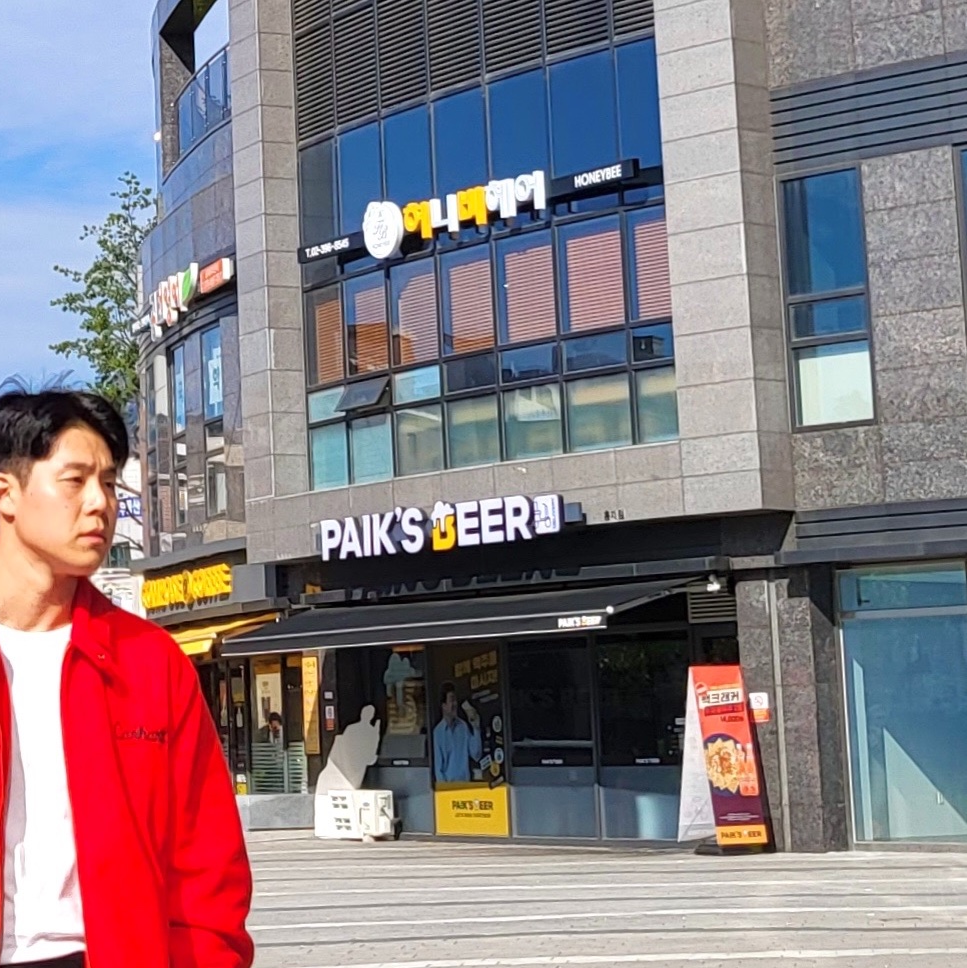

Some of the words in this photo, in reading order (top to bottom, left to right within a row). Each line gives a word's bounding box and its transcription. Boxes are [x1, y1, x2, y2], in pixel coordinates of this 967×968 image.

[574, 163, 622, 188] HONEYBEE
[320, 506, 424, 562] PAIK'S
[430, 495, 532, 552] BEER
[452, 800, 474, 811] PAIK'S
